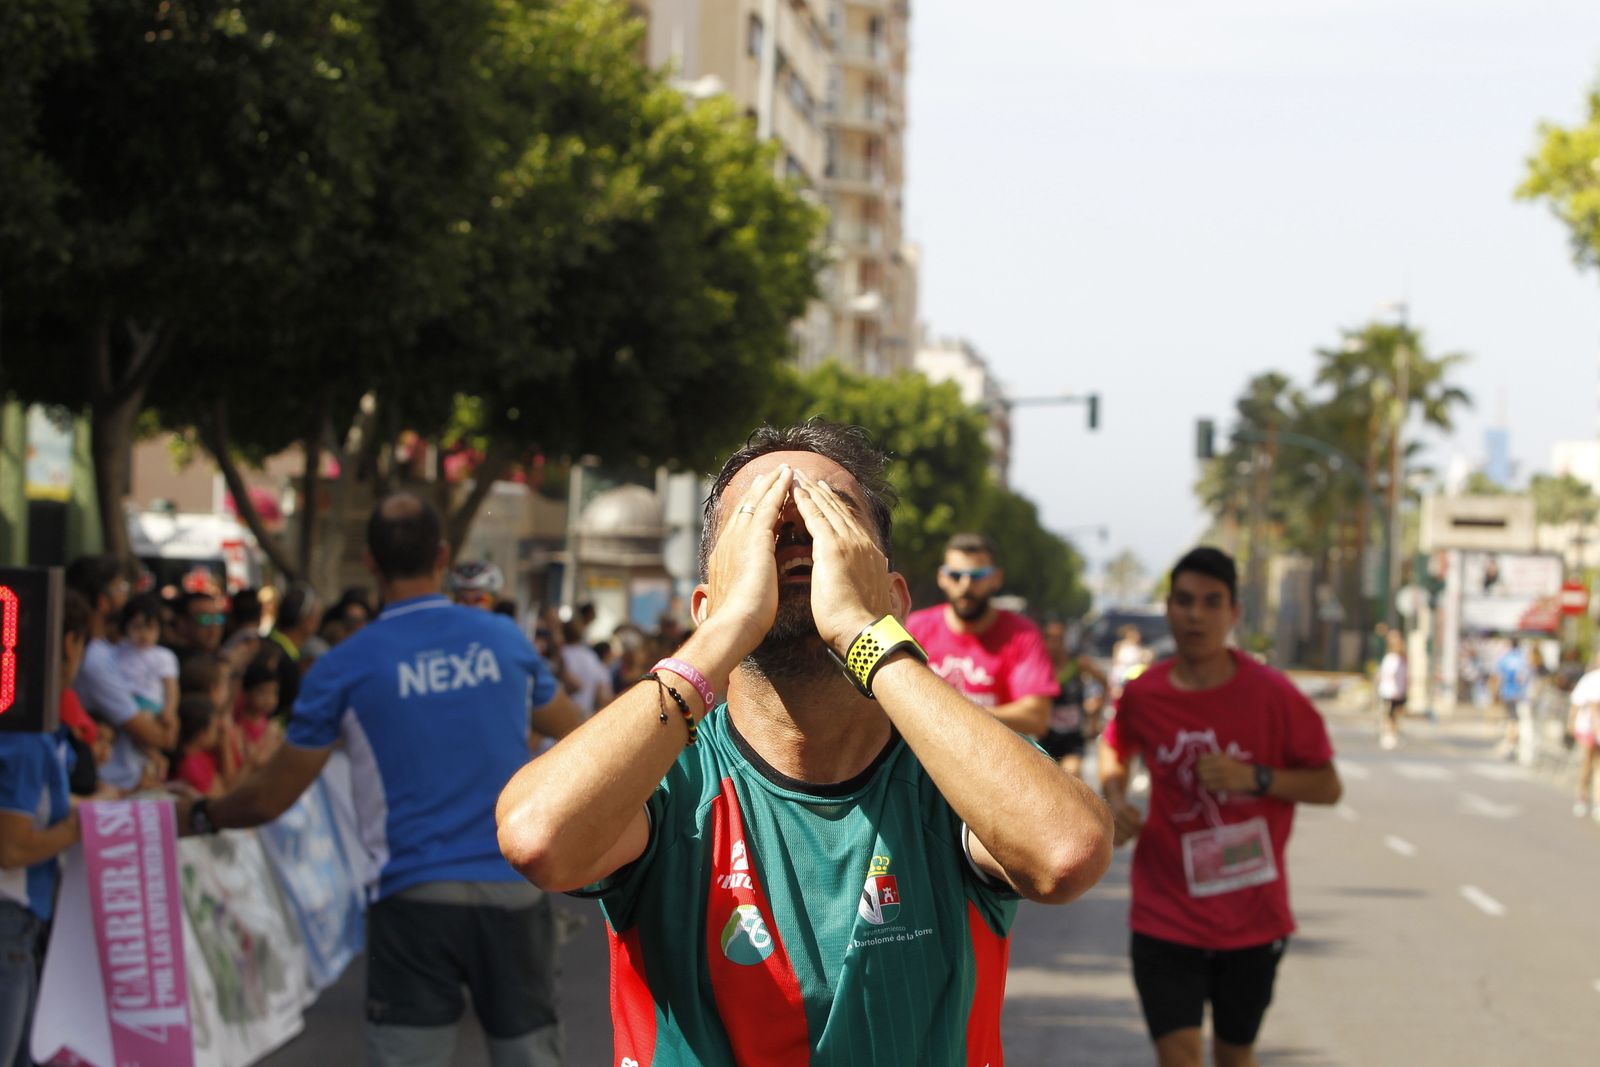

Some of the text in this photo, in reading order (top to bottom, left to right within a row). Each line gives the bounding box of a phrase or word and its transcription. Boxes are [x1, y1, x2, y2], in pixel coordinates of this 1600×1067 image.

[397, 642, 502, 699] NEXA
[100, 842, 149, 1008] CARRERA
[896, 933, 906, 942] de
[906, 933, 914, 941] la
[151, 931, 173, 965] LAS
[153, 966, 177, 1004] POR
[111, 1004, 189, 1043] 4
